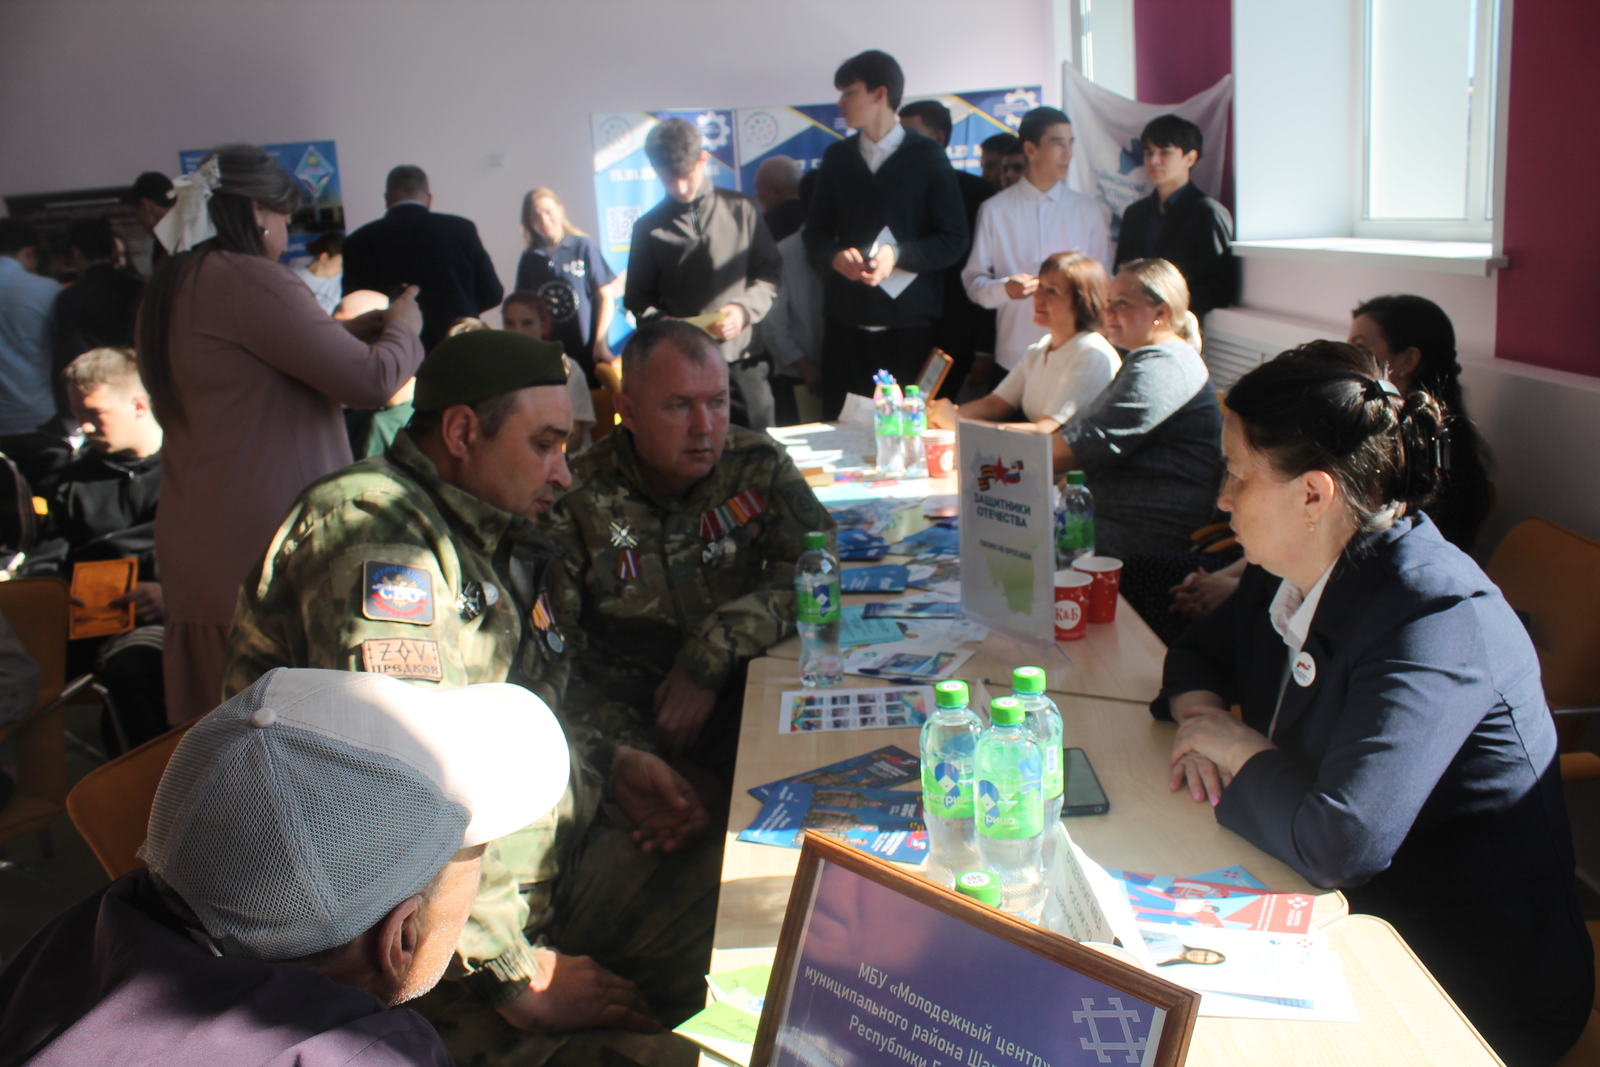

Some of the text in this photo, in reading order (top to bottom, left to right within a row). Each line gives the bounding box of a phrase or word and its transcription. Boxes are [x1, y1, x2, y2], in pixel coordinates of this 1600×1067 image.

[973, 492, 1031, 516] ЗАЩИТНИКИ
[976, 506, 1028, 528] ОТЕЧЕСТВА
[380, 584, 421, 603] СВО
[803, 965, 909, 1031] муниципального
[911, 1023, 964, 1061] района
[857, 962, 889, 990] МБУ
[889, 982, 993, 1045] «Молодежный
[849, 1014, 927, 1067] Республики
